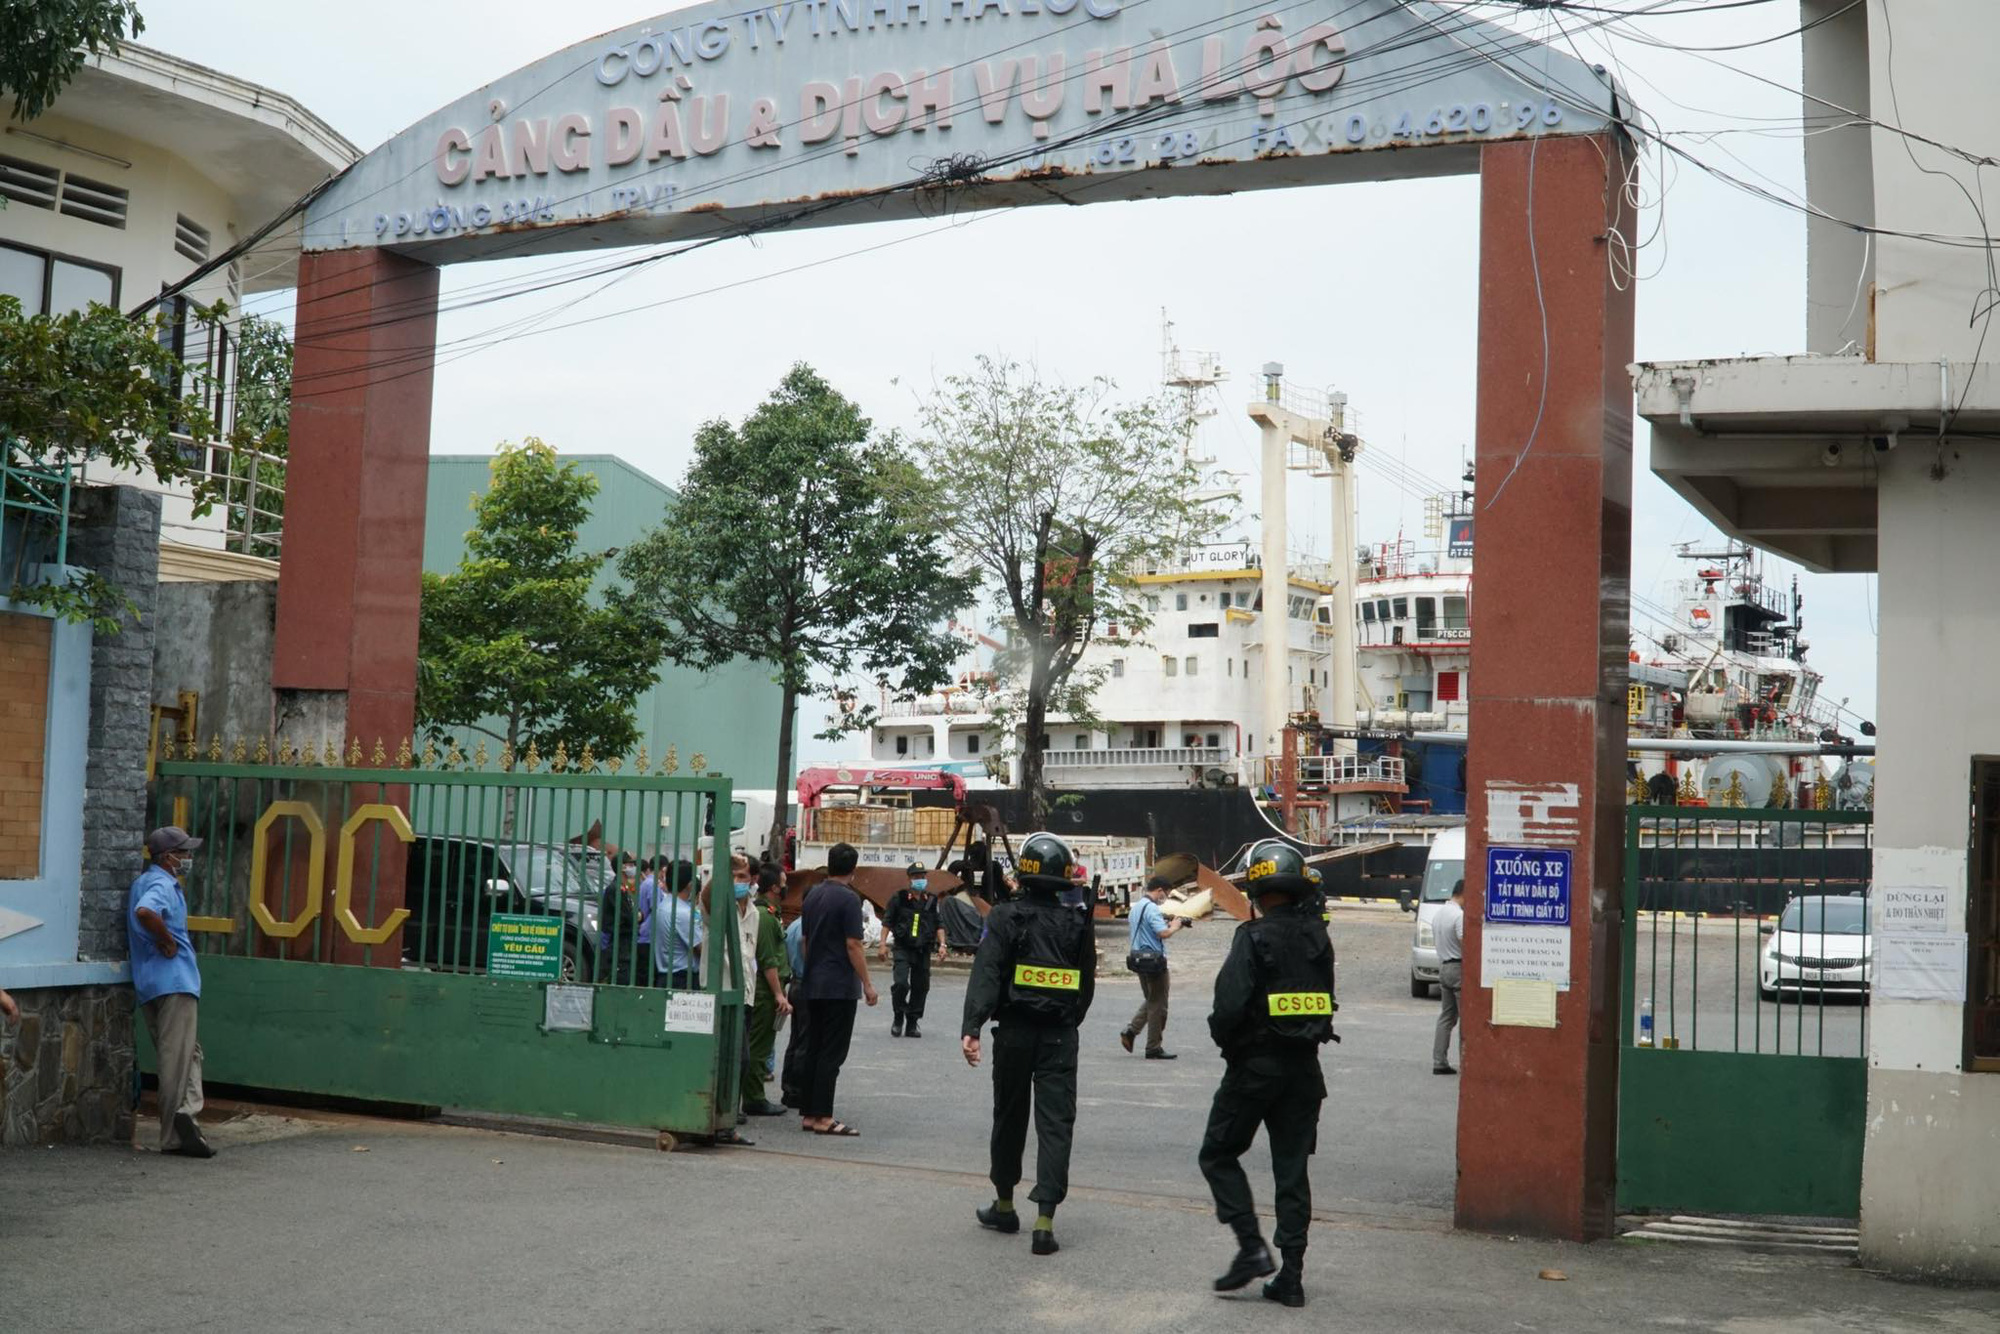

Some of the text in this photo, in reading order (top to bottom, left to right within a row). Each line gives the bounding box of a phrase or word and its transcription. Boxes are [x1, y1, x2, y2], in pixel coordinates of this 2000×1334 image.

[744, 4, 795, 50] TY
[435, 99, 592, 186] CẢNG
[607, 75, 730, 168] DẦU
[746, 96, 783, 148] &
[799, 65, 954, 157] DỊCH
[972, 51, 1067, 140] VỤ
[1201, 11, 1346, 117] LỘC
[1209, 551, 1246, 562] GLORY
[1494, 853, 1564, 877] XUỐNG XE
[1513, 881, 1530, 897] MÁY
[1277, 997, 1326, 1012] CSCĐ
